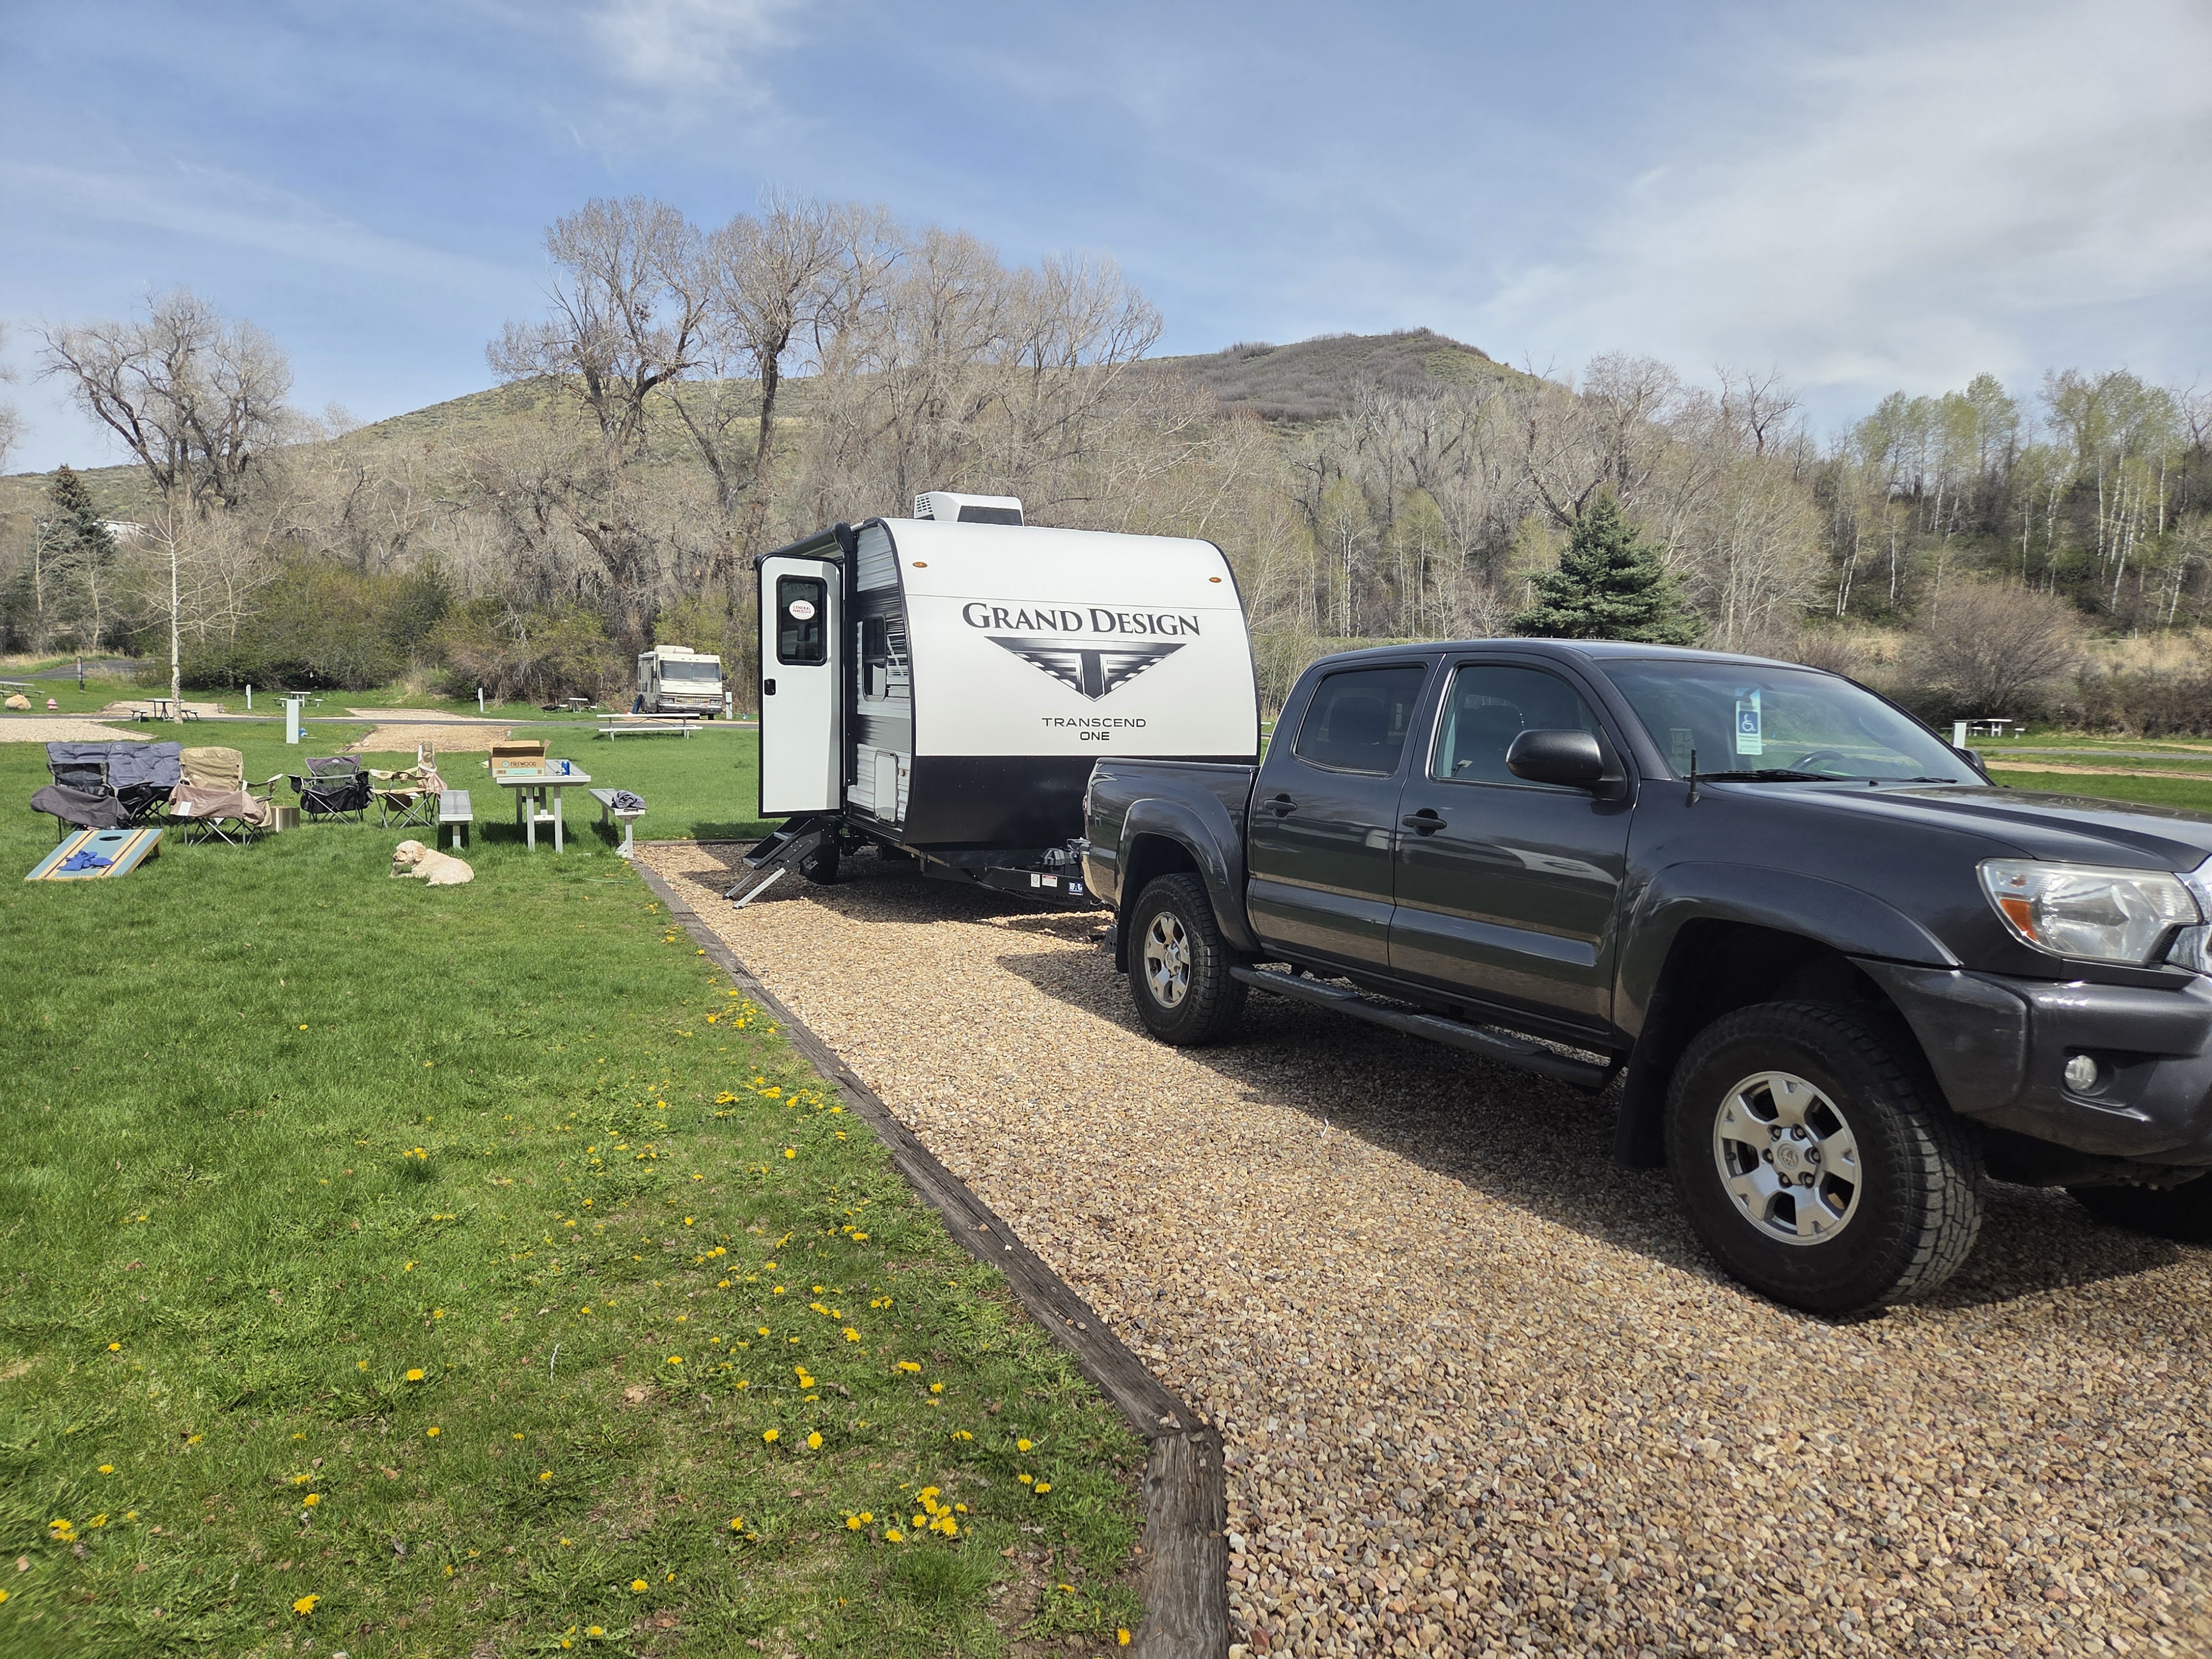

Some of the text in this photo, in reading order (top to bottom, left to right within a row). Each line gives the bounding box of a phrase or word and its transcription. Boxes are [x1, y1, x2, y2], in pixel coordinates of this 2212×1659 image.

[962, 602, 1201, 636] GRAND DESIGN
[1041, 717, 1146, 728] TRANSCEND
[1079, 731, 1110, 740] ONE
